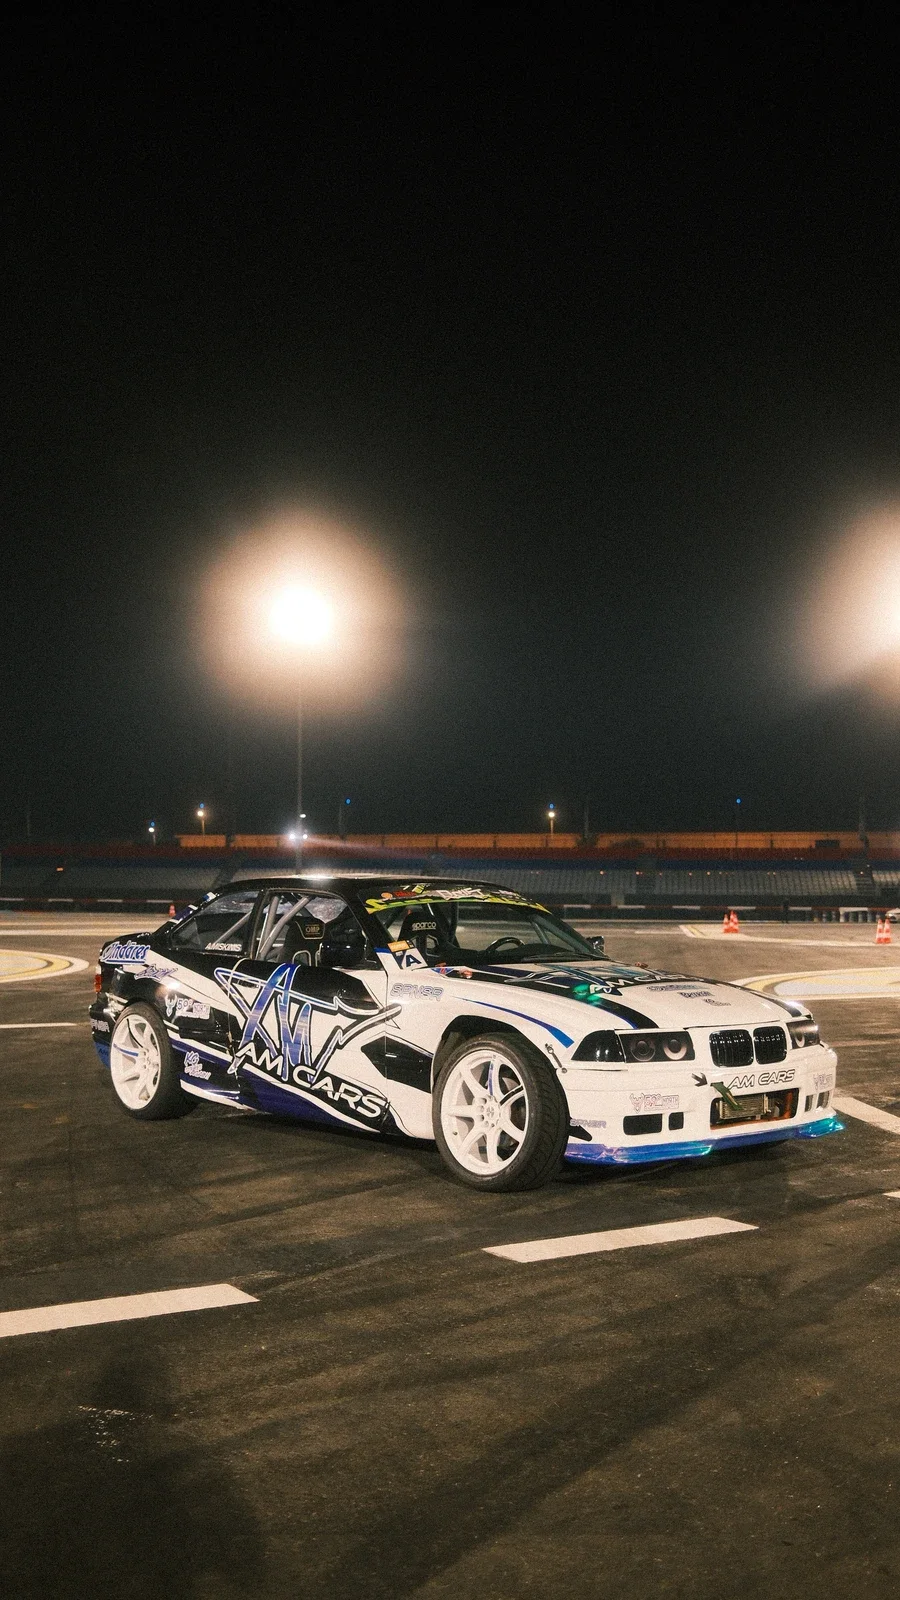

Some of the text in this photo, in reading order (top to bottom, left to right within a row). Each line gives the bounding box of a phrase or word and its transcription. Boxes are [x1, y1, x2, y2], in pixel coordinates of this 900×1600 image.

[235, 1041, 388, 1118] AM CARS
[728, 1074, 755, 1089] AM
[758, 1068, 796, 1086] CARS
